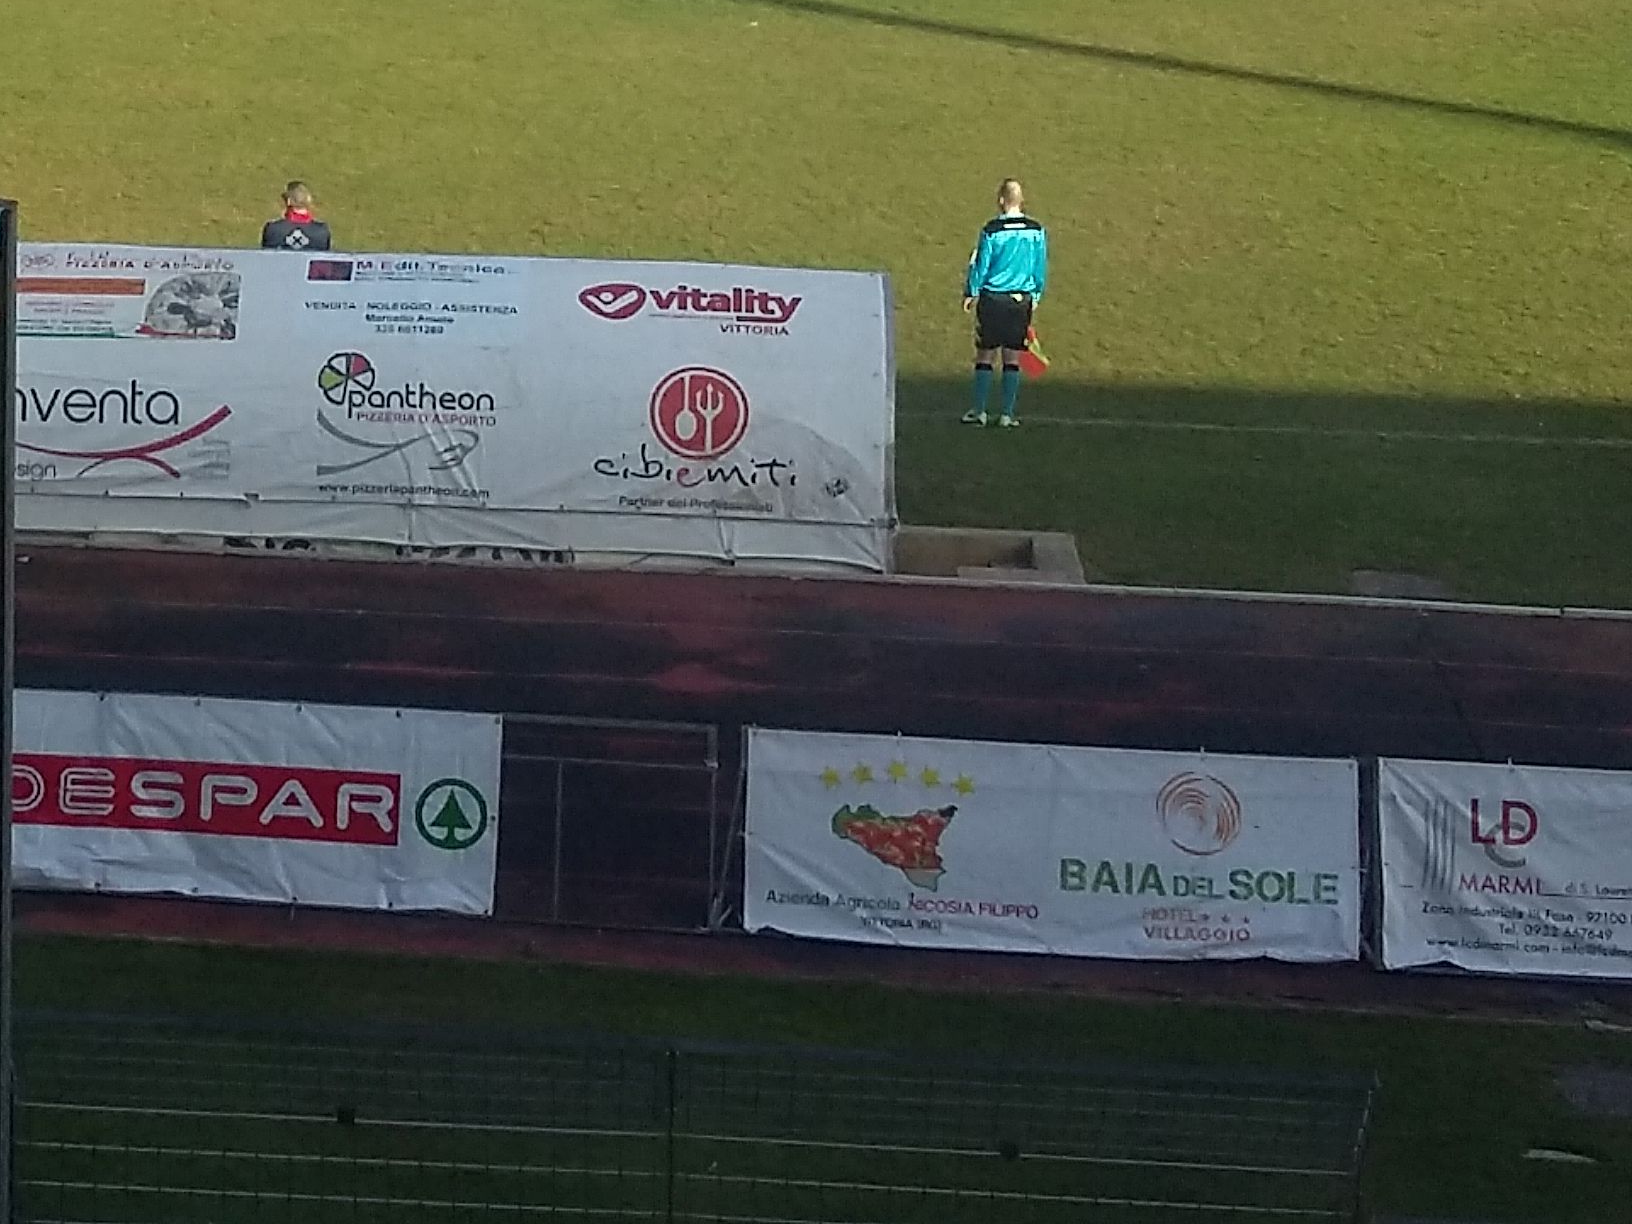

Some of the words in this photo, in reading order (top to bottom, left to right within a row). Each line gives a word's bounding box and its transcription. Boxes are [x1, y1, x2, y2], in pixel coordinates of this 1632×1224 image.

[304, 300, 357, 311] VENDITA
[366, 301, 432, 312] NOLEGGIO
[441, 303, 518, 315] ASSISTENZA
[649, 285, 803, 324] vitality
[719, 324, 790, 336] VITTORIA
[348, 383, 495, 418] pantheon
[357, 411, 415, 423] PIZZERIA
[419, 413, 497, 427] D'ASPORTO
[14, 459, 57, 481] sign
[593, 443, 797, 487] cibiemiti
[318, 484, 490, 499] www.pizzeriapantheon.com
[619, 495, 664, 508] Partner
[12, 764, 395, 834] DESPAR
[1059, 857, 1167, 897] BAIA
[1172, 874, 1225, 900] DEL
[1227, 867, 1340, 906] SOLE
[1458, 871, 1542, 896] MARMI
[766, 888, 831, 907] Azienda
[835, 893, 901, 913] Agricola
[978, 901, 1039, 920] FILIPPO
[1143, 906, 1197, 923] HOTEL
[1585, 910, 1627, 925] 97100
[1143, 925, 1252, 942] VILLAGGIO
[1524, 923, 1559, 938] 0932
